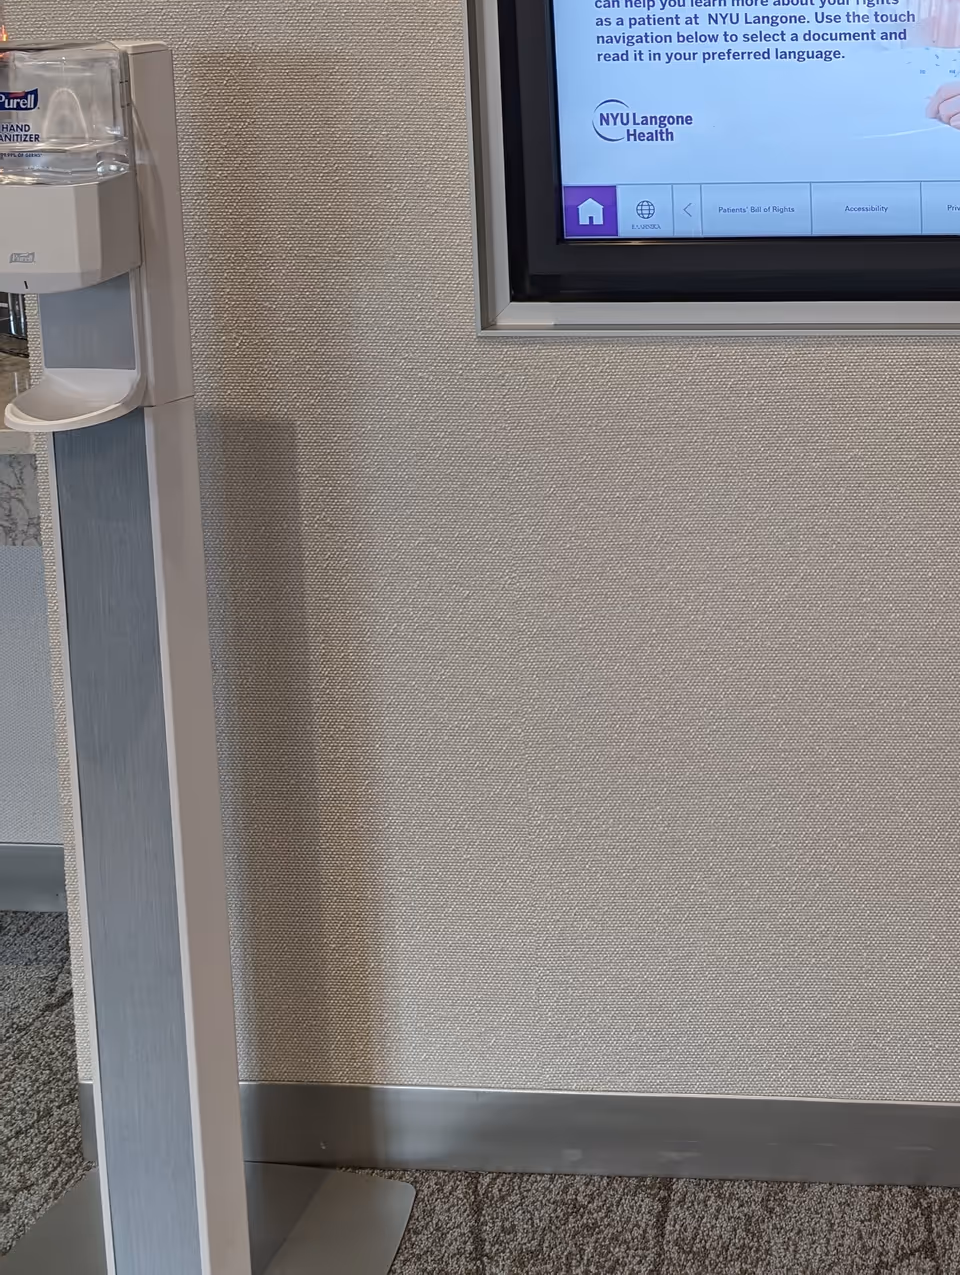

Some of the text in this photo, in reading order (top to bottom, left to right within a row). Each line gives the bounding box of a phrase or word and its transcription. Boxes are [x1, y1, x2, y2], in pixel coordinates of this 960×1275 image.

[595, 11, 915, 28] as a patient at NYU Langone. Use the touch
[596, 29, 906, 46] navigation below to select a document and
[597, 48, 845, 63] read it in your preferred language.
[599, 113, 693, 128] NYU Langone
[2, 124, 30, 132] HAND
[0, 134, 39, 142] ANITIZER
[626, 129, 674, 142] Health
[772, 206, 795, 214] Rights
[845, 205, 888, 213] Accessibility
